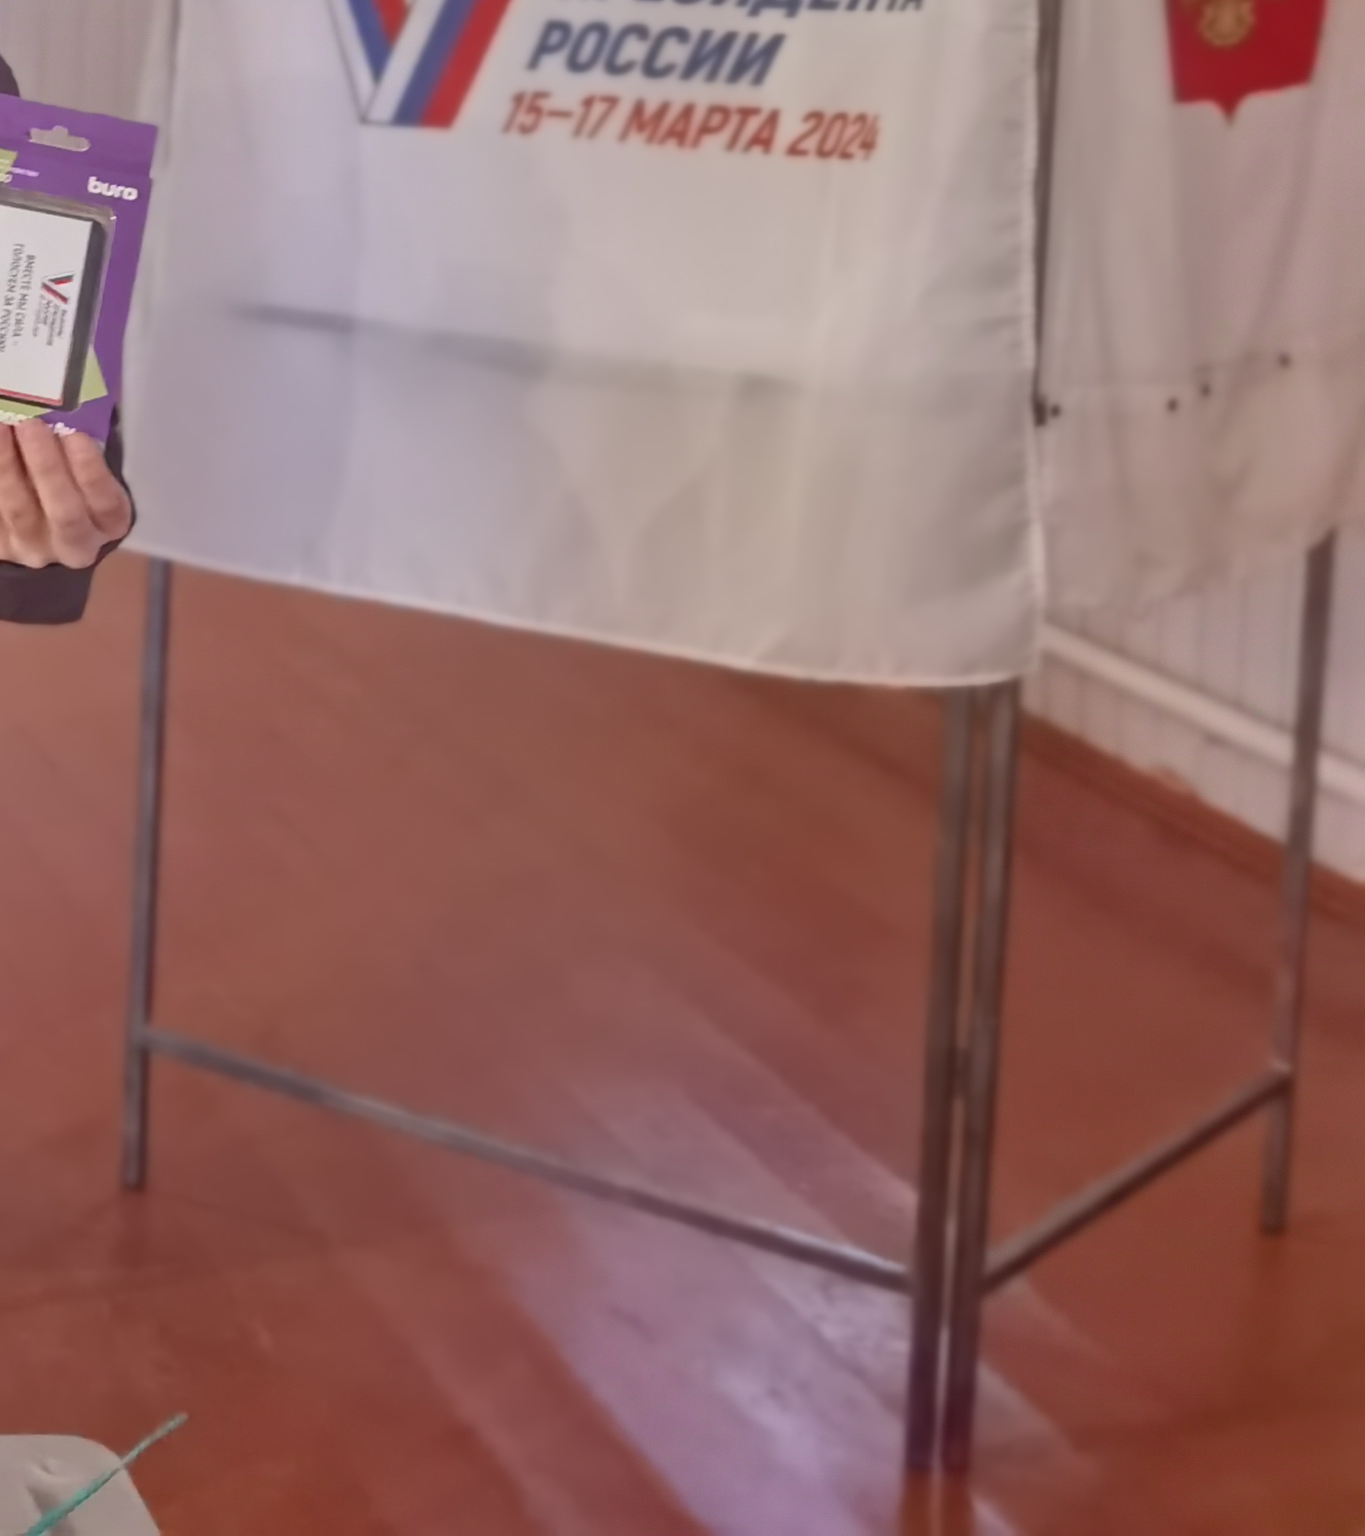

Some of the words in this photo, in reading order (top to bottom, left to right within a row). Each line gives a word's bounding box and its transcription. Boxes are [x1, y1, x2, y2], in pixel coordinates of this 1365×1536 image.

[526, 20, 787, 86] РОССИИ
[619, 98, 780, 155] МАРТА
[786, 110, 880, 160] 2024
[87, 175, 138, 201] buro
